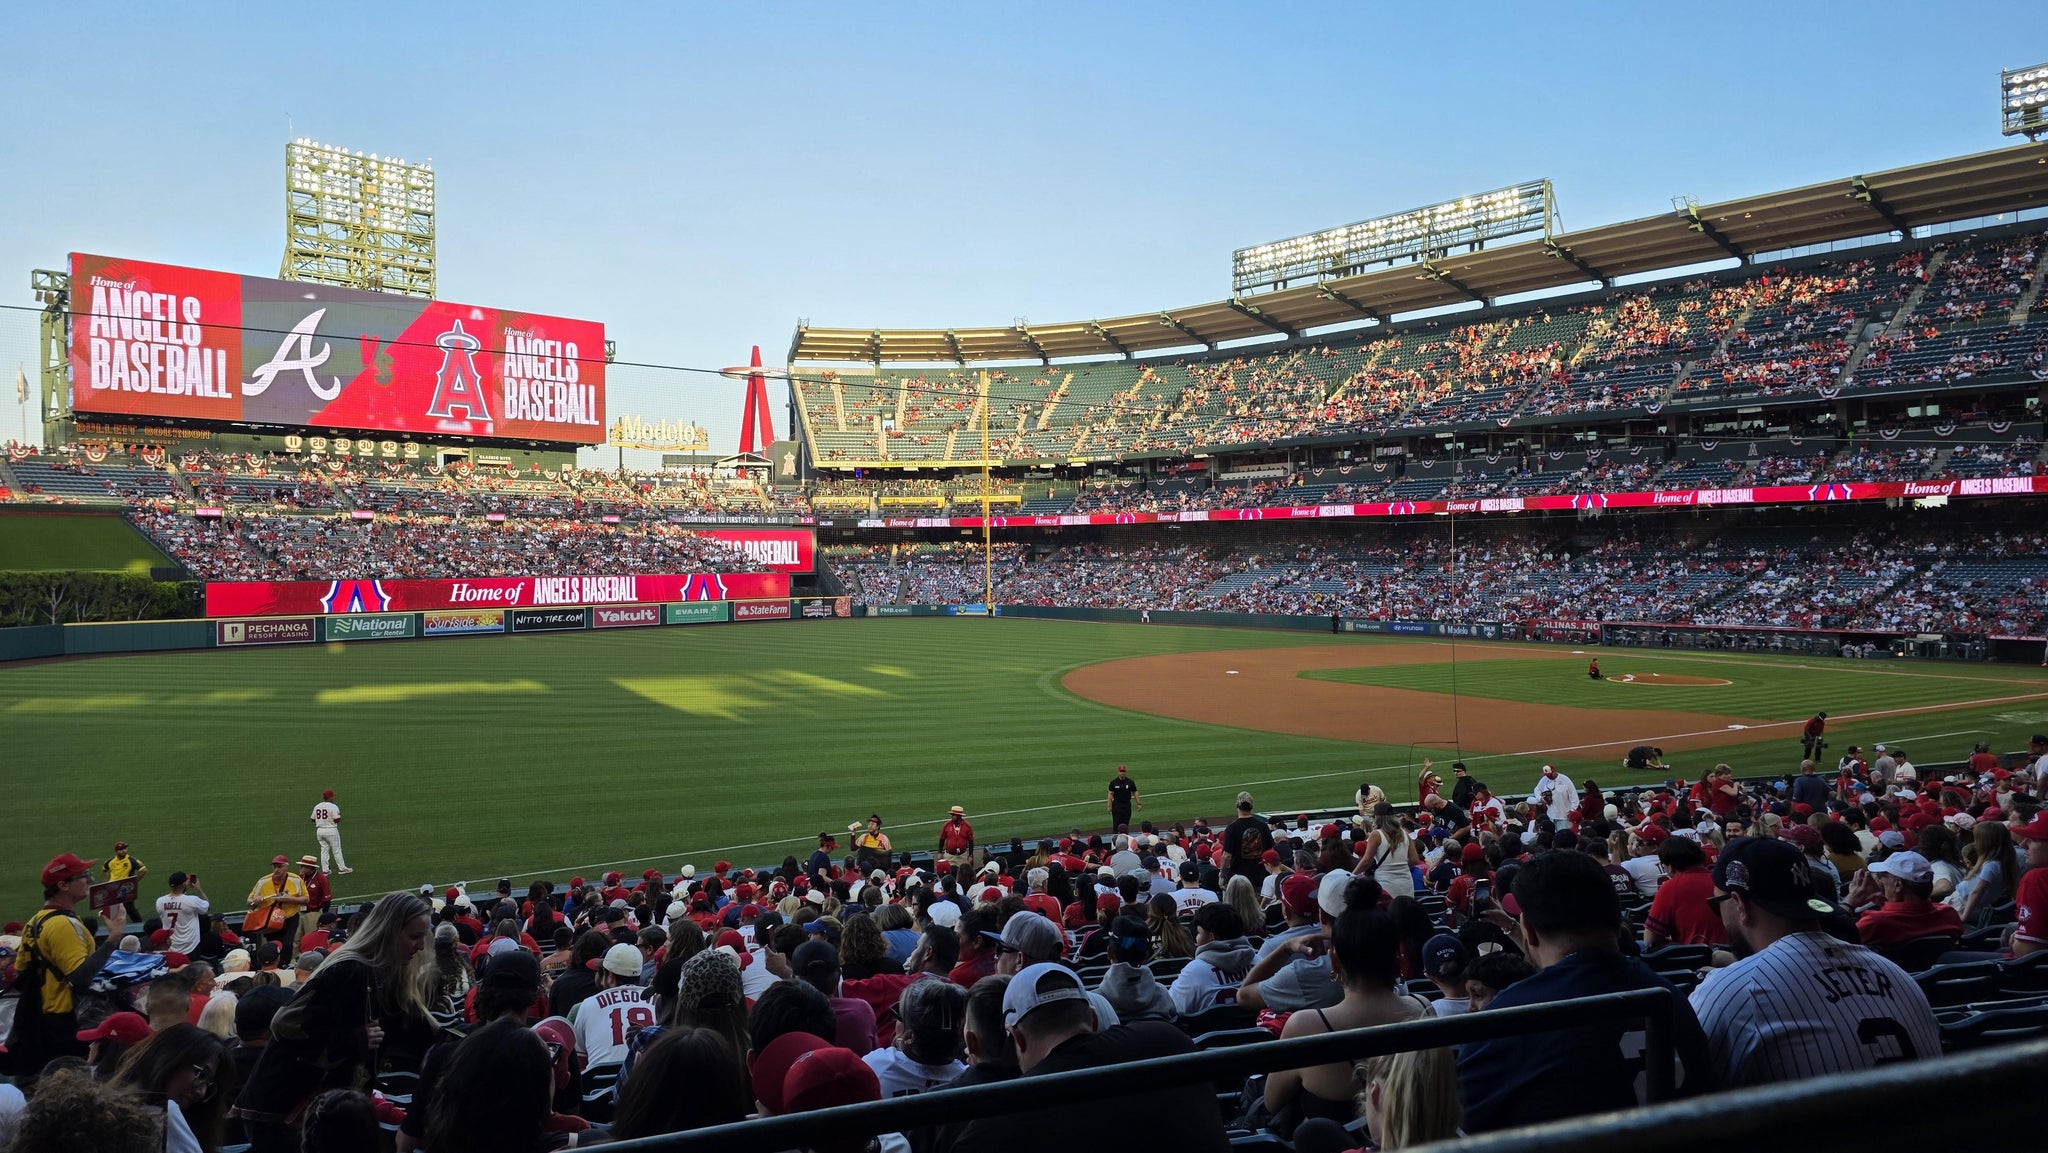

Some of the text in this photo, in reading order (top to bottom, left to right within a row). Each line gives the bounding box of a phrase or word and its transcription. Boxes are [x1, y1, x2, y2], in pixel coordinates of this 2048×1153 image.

[90, 276, 136, 292] Home of
[90, 285, 201, 347] ANGELS
[504, 327, 535, 339] Home of
[504, 335, 579, 383] ANGELS
[90, 336, 232, 399] BASEBALL
[504, 377, 600, 426] BASEBALL
[144, 426, 212, 440] BOURBON
[623, 413, 696, 443] Modelo
[289, 437, 298, 446] 11
[312, 438, 325, 448] 26
[336, 439, 349, 448] 29
[360, 440, 372, 450] 30
[383, 442, 395, 451] 42
[406, 443, 418, 452] 50
[1904, 476, 2034, 496] Home of ANGELS BASEBALL
[1653, 488, 1754, 505] Home of ANGELS BASEBALL
[1446, 498, 1525, 512] Home of ANGELS BASEBALL
[1157, 513, 1171, 522] Home
[1171, 512, 1179, 522] of
[1291, 507, 1309, 516] Home
[1309, 507, 1316, 517] of
[684, 516, 717, 524] COUNTDOWN
[717, 516, 726, 524] TO
[726, 516, 741, 524] FIRST
[743, 516, 759, 524] PITCH
[889, 518, 907, 526] Home
[908, 518, 916, 527] of
[1035, 516, 1051, 525] Home
[1052, 516, 1059, 526] of
[449, 576, 638, 605] Home of ANGELS BASEBALL
[516, 613, 583, 625] NITTO TIRE.COM
[598, 608, 655, 623] Yakult
[248, 623, 308, 633] PECHANGA
[351, 618, 407, 631] National
[428, 615, 475, 630] Surfside
[248, 631, 278, 639] RESORT
[383, 629, 405, 637] Rental
[1447, 625, 1468, 635] Modelo
[315, 808, 329, 820] 88
[1184, 898, 1206, 907] TROUT
[167, 912, 178, 929] 7
[1813, 966, 1896, 1003] JETER
[596, 989, 640, 1009] DIEGO
